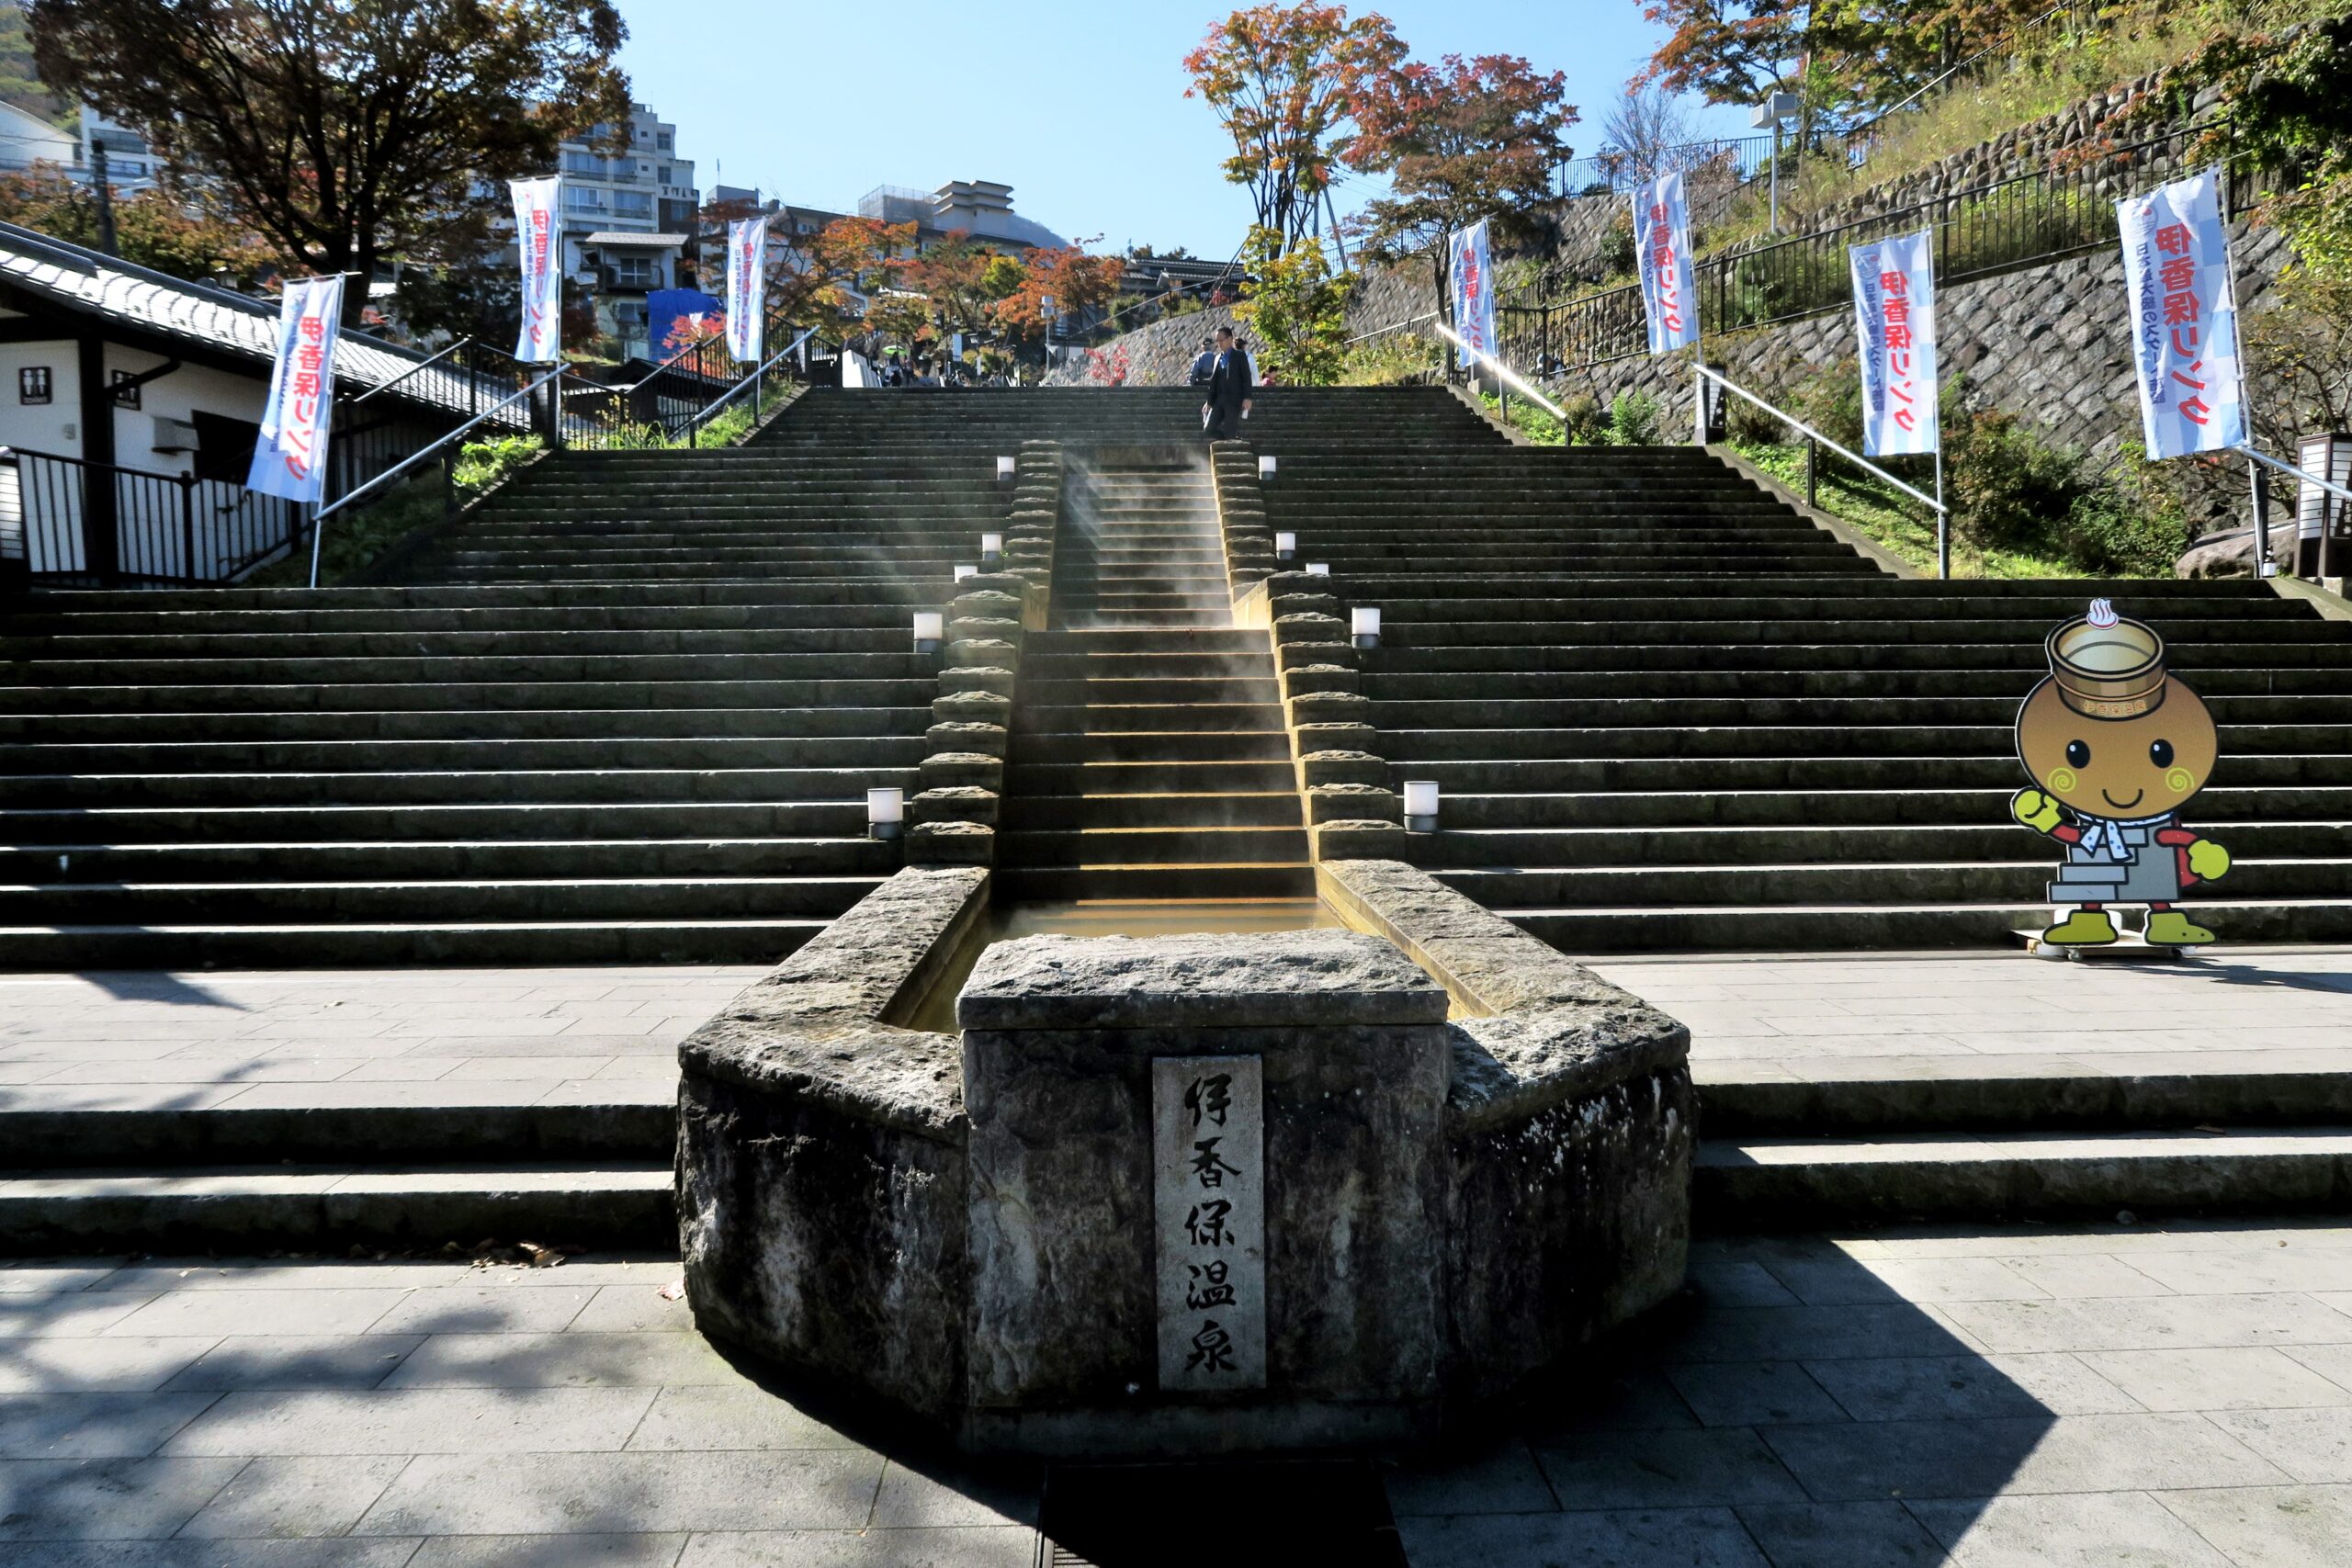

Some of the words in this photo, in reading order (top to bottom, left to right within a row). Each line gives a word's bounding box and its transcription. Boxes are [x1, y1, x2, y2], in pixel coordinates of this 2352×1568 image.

[1184, 1073, 1241, 1373] 伊香保温泉
